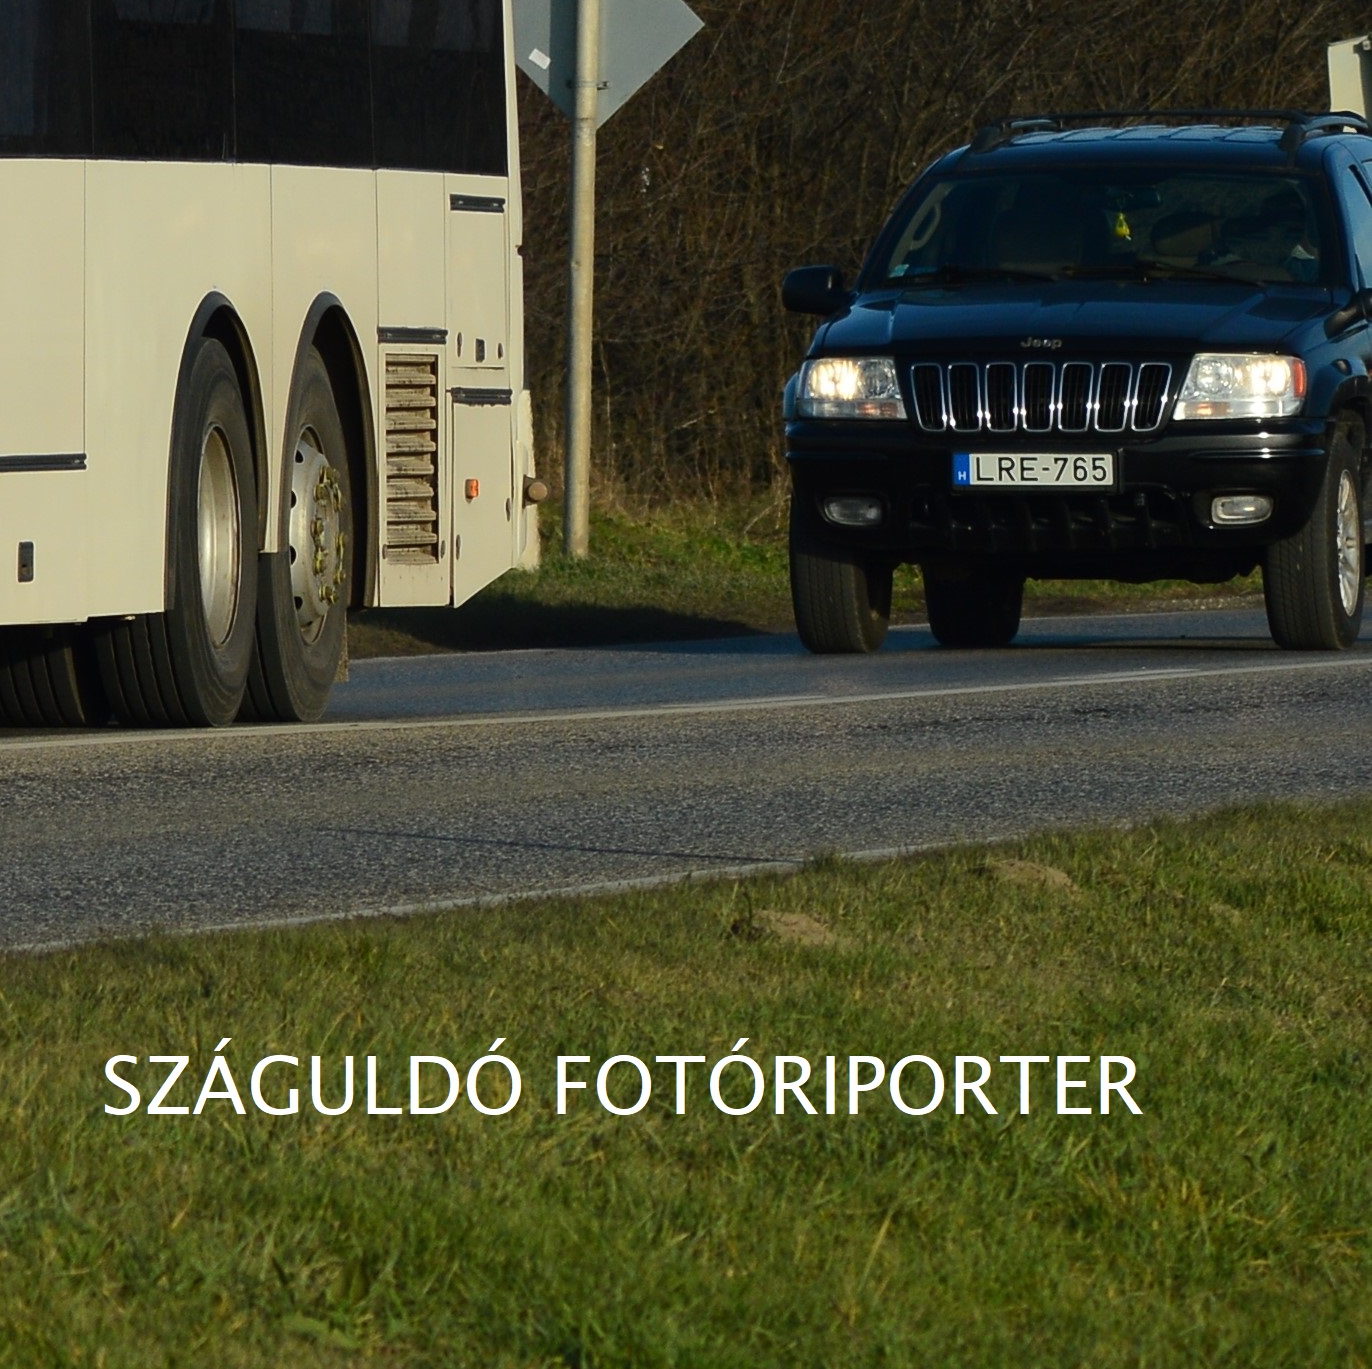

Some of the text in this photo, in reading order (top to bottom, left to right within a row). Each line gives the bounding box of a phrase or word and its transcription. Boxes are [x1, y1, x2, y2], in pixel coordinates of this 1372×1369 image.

[1020, 337, 1063, 350] Jeep
[957, 456, 1107, 482] H LRE-765
